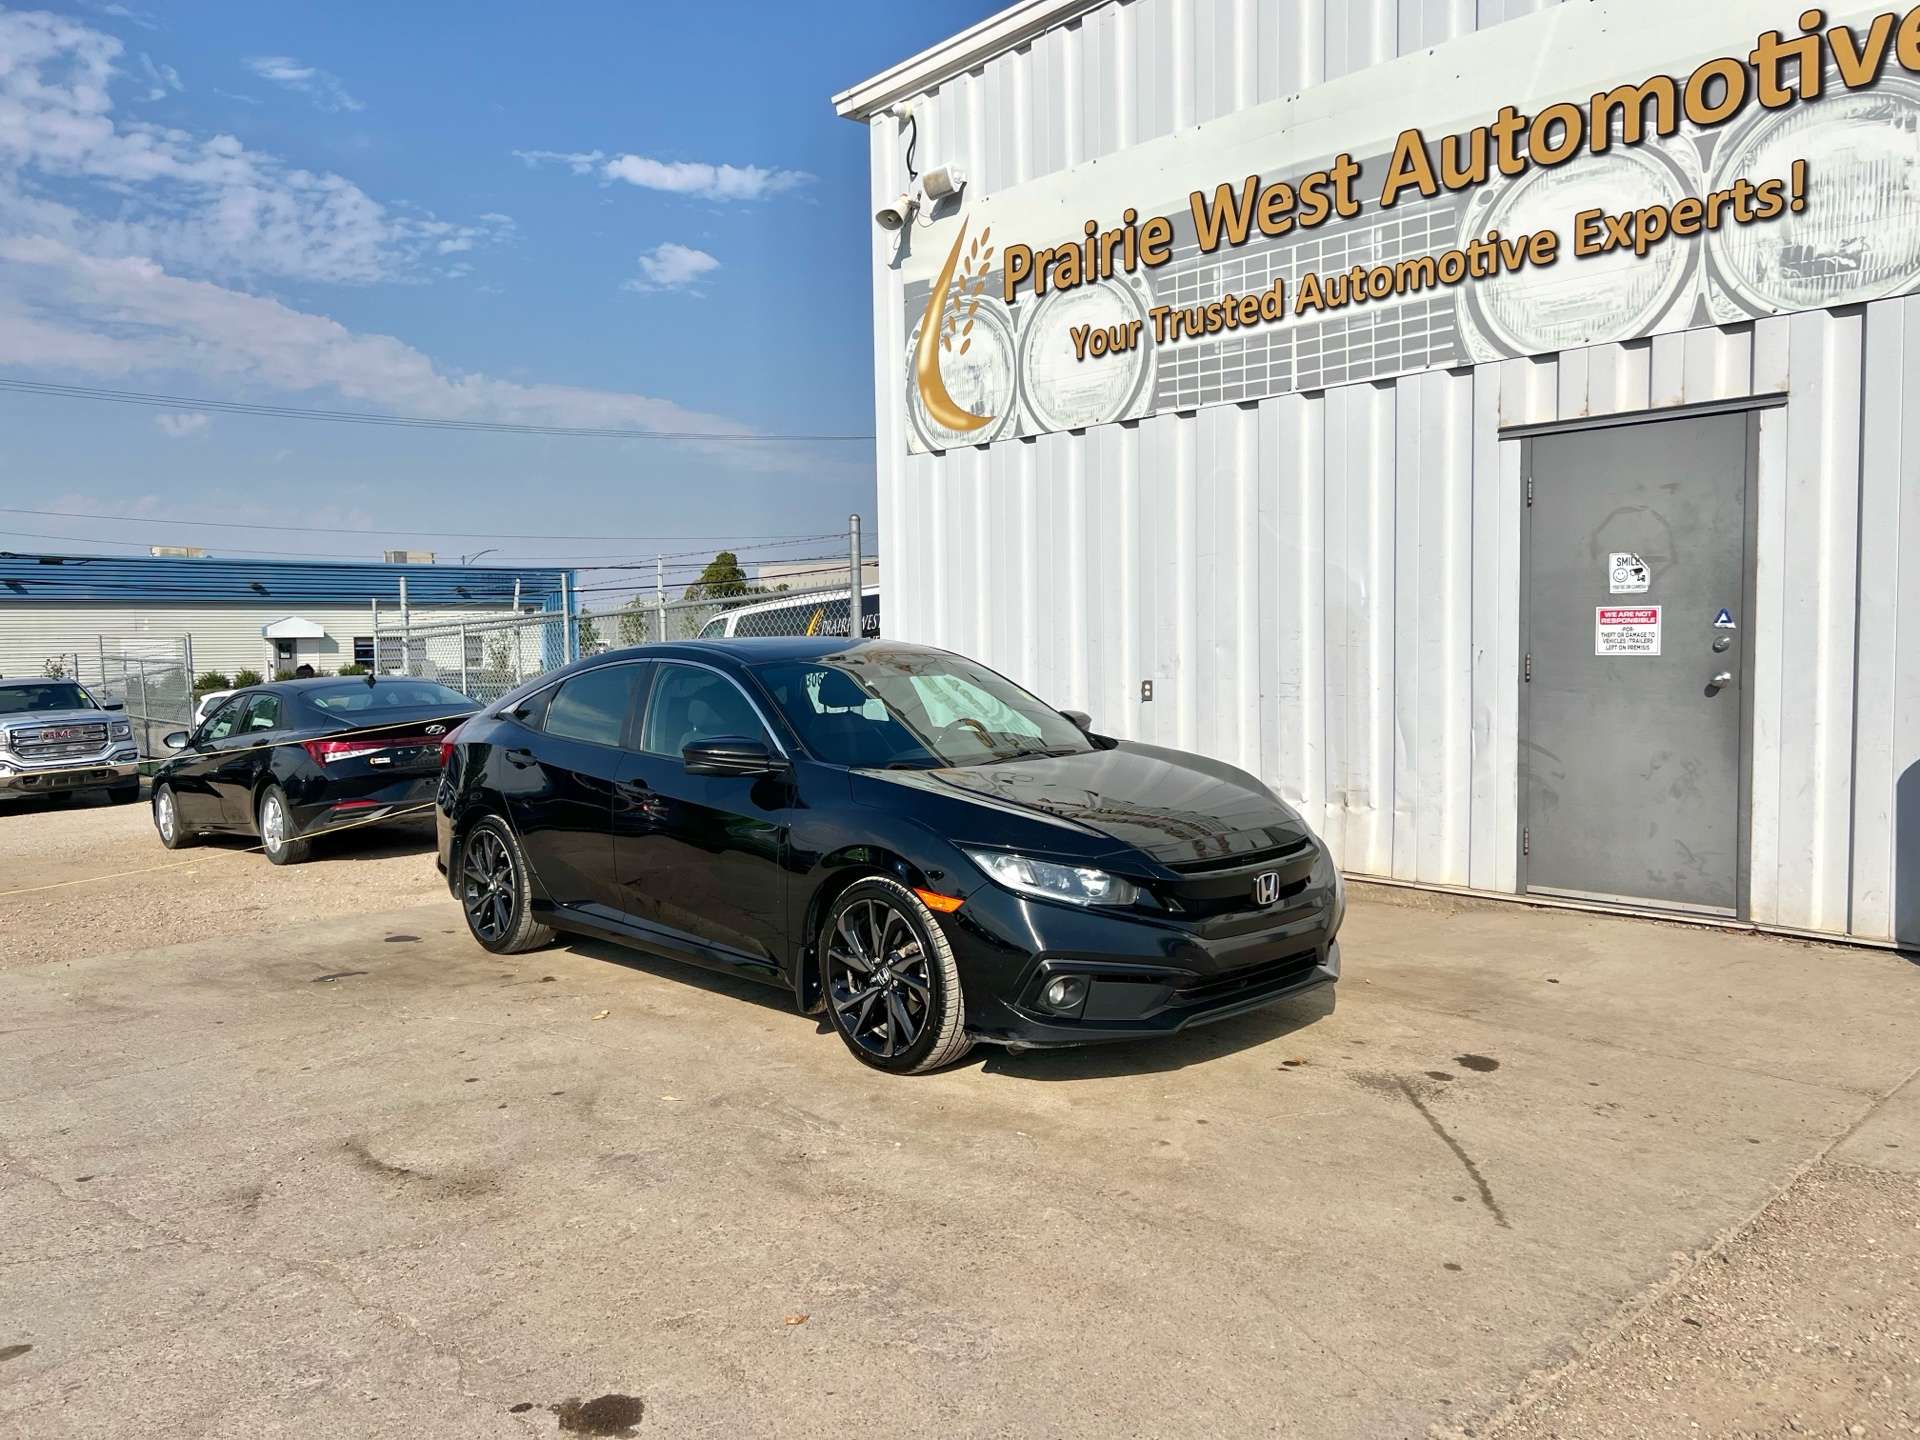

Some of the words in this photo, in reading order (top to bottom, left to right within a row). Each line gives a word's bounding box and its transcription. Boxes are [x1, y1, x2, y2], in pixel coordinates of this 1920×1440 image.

[1003, 208, 1172, 302] Prairie
[1189, 153, 1359, 253] West
[1070, 317, 1142, 360] Your
[1149, 277, 1284, 343] Trusted
[1294, 230, 1557, 314] Automotive
[1574, 158, 1807, 257] Experts!
[821, 617, 851, 635] PRAIRI
